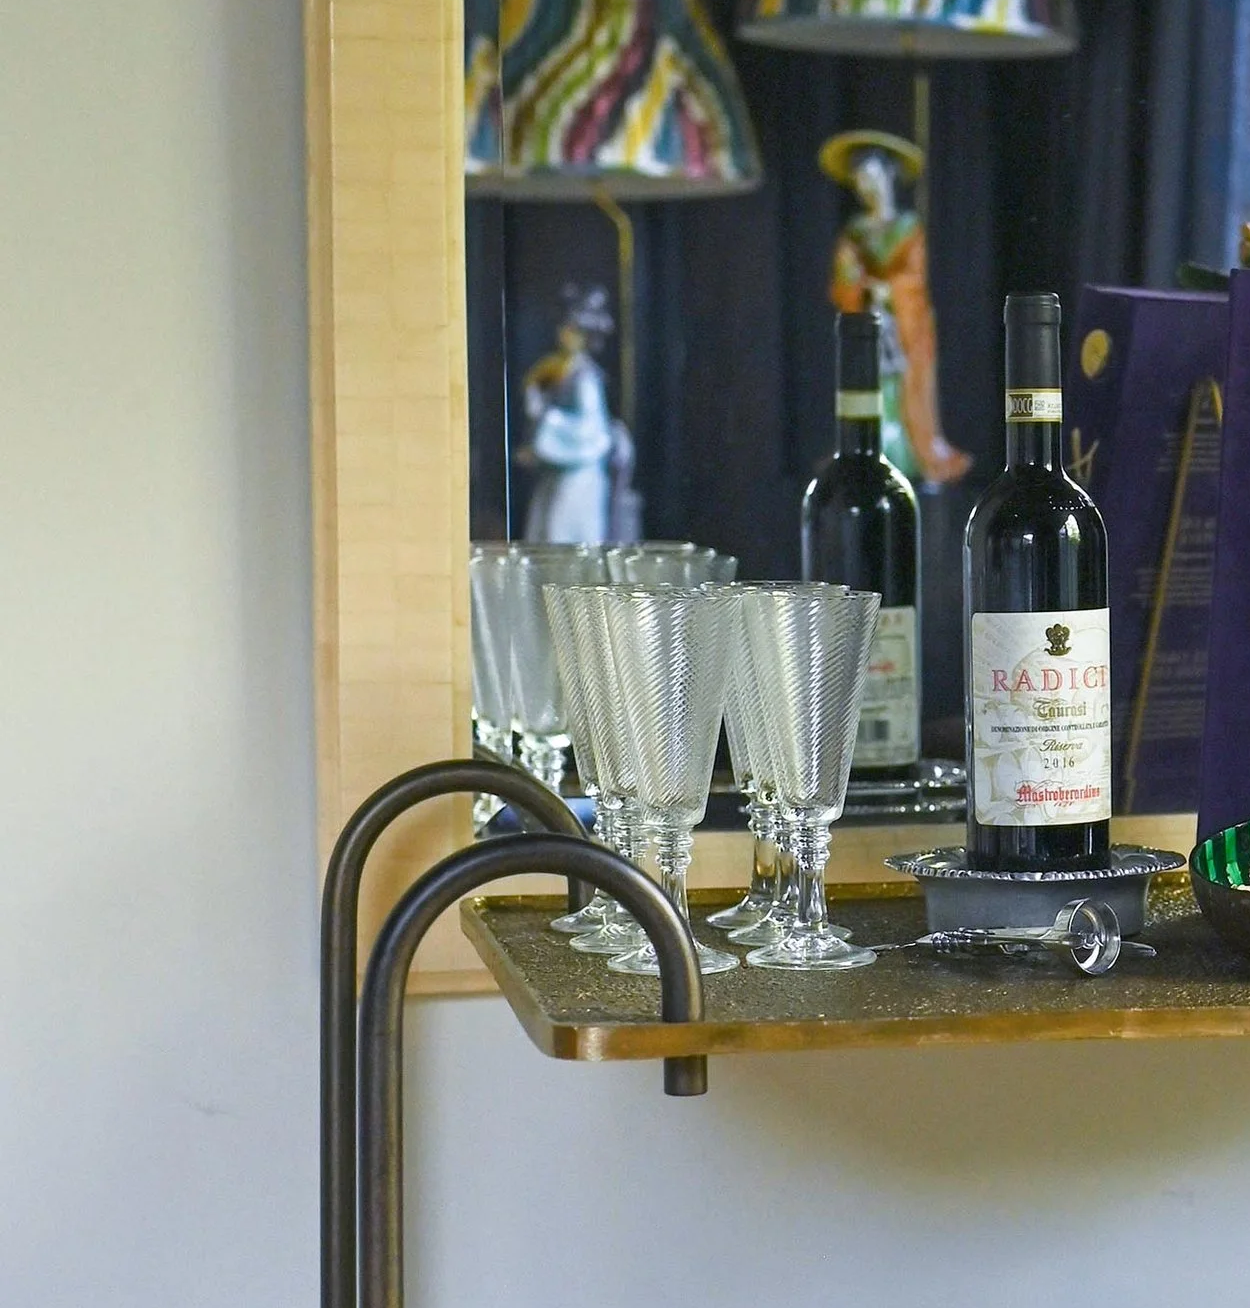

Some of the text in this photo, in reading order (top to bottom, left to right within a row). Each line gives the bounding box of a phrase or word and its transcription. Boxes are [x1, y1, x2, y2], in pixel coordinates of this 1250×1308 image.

[991, 664, 1109, 692] RADICI
[1032, 697, 1087, 720] Taurasi
[1039, 738, 1084, 752] Riserva
[1043, 756, 1075, 769] 2016
